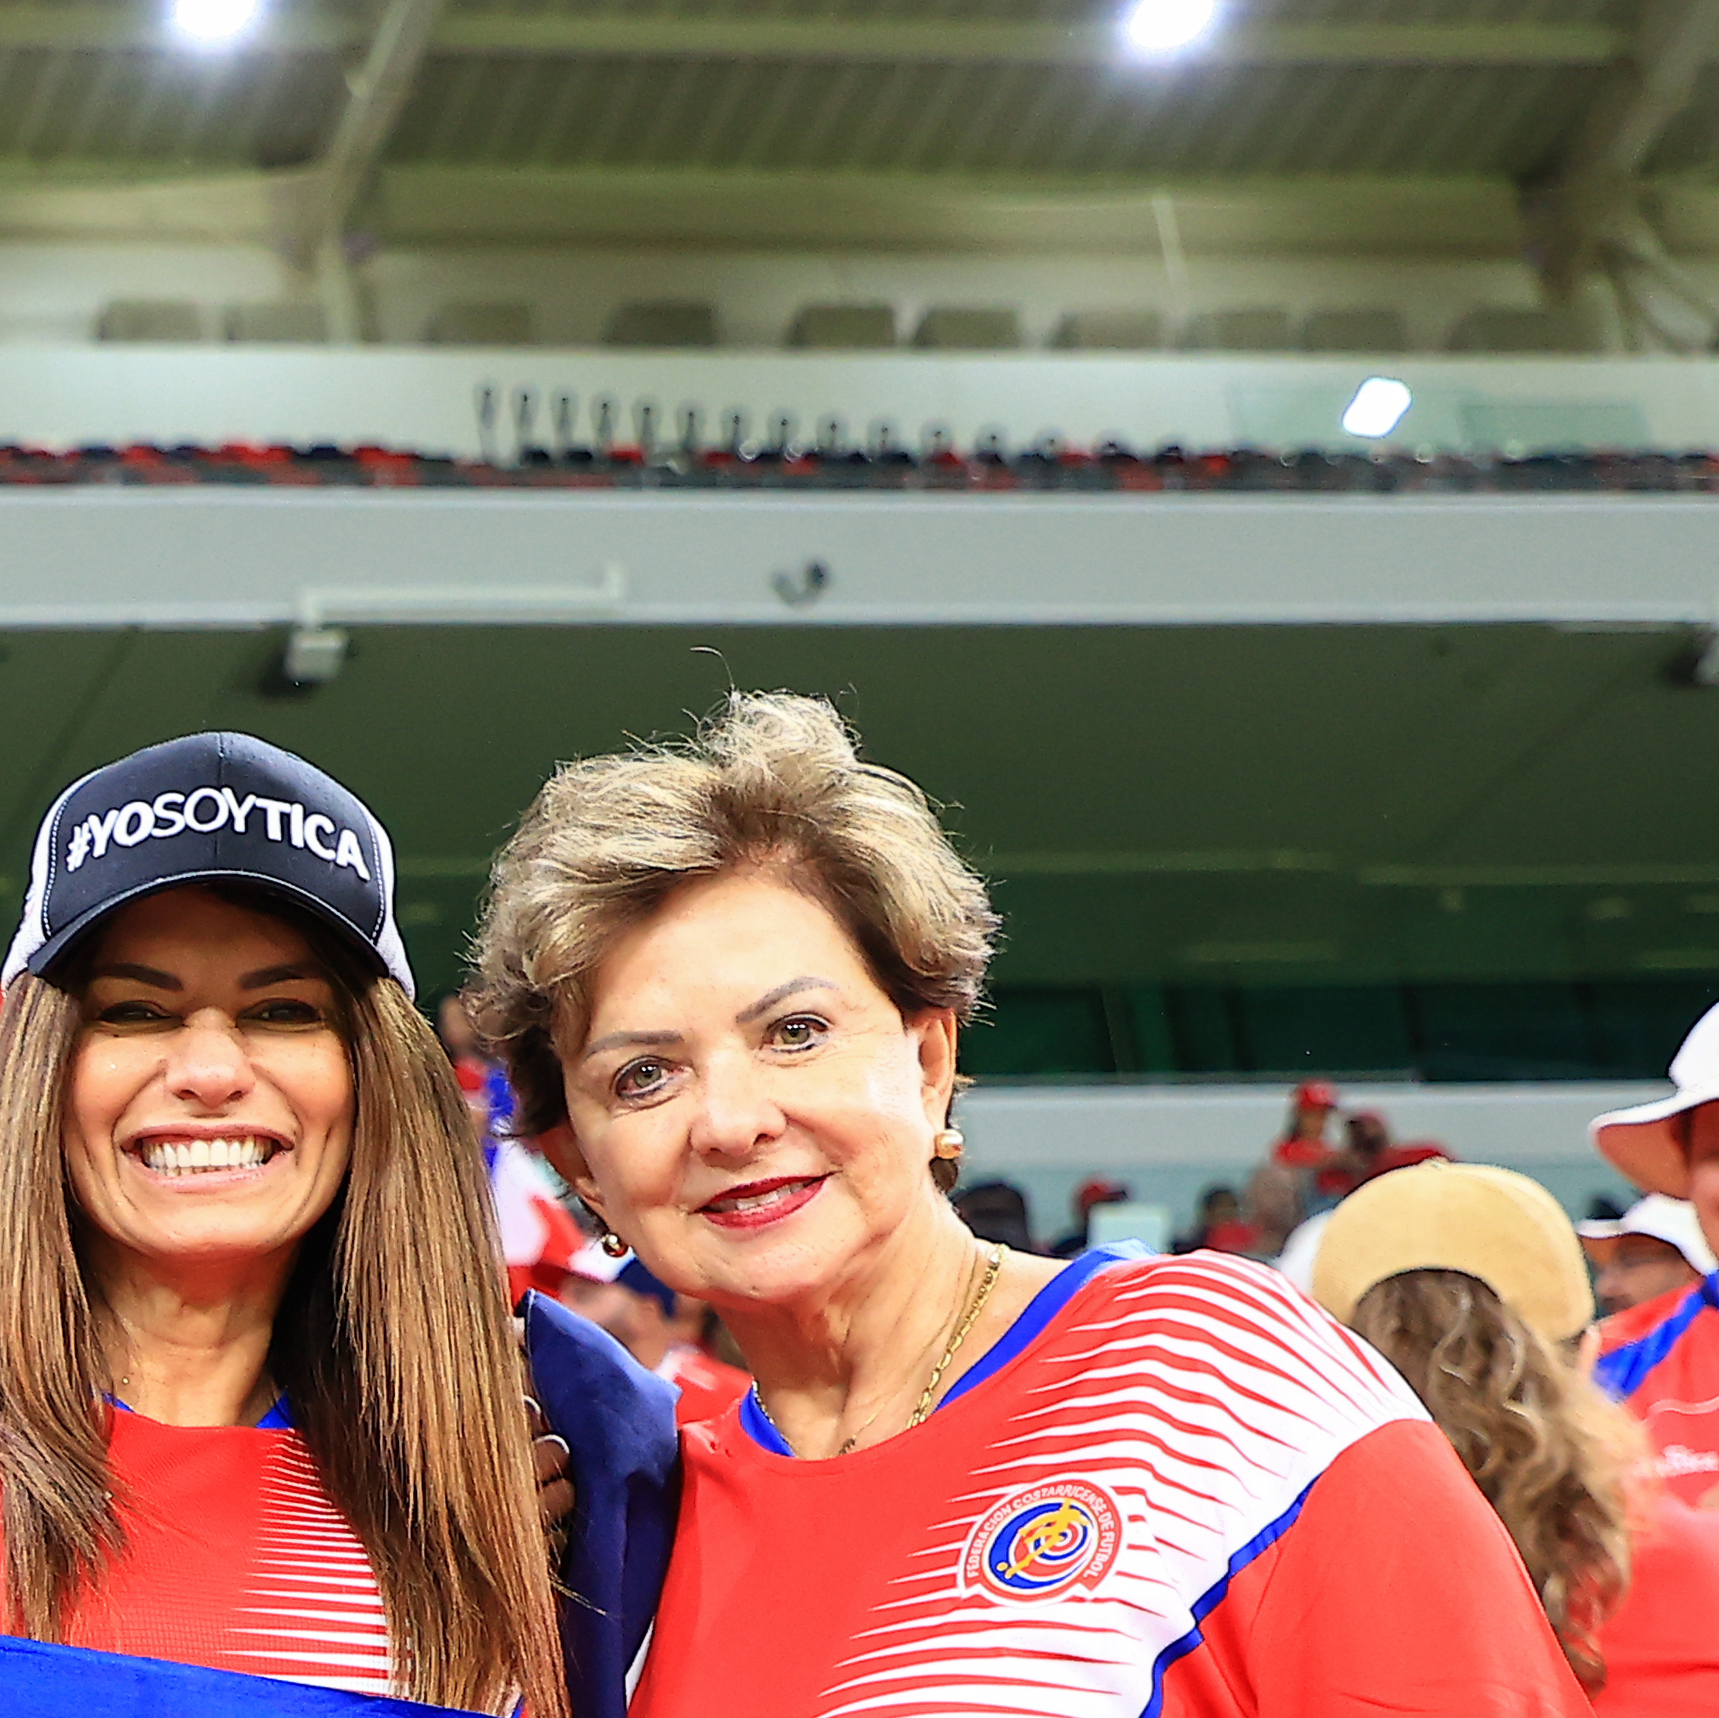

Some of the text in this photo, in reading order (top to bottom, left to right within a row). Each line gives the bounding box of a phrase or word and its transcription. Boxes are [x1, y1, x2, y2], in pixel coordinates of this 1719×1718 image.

[66, 787, 371, 882] #YOSOYTICA
[967, 1484, 1116, 1579] FEDERACION COSTARRICENSE DE FUTBOL
